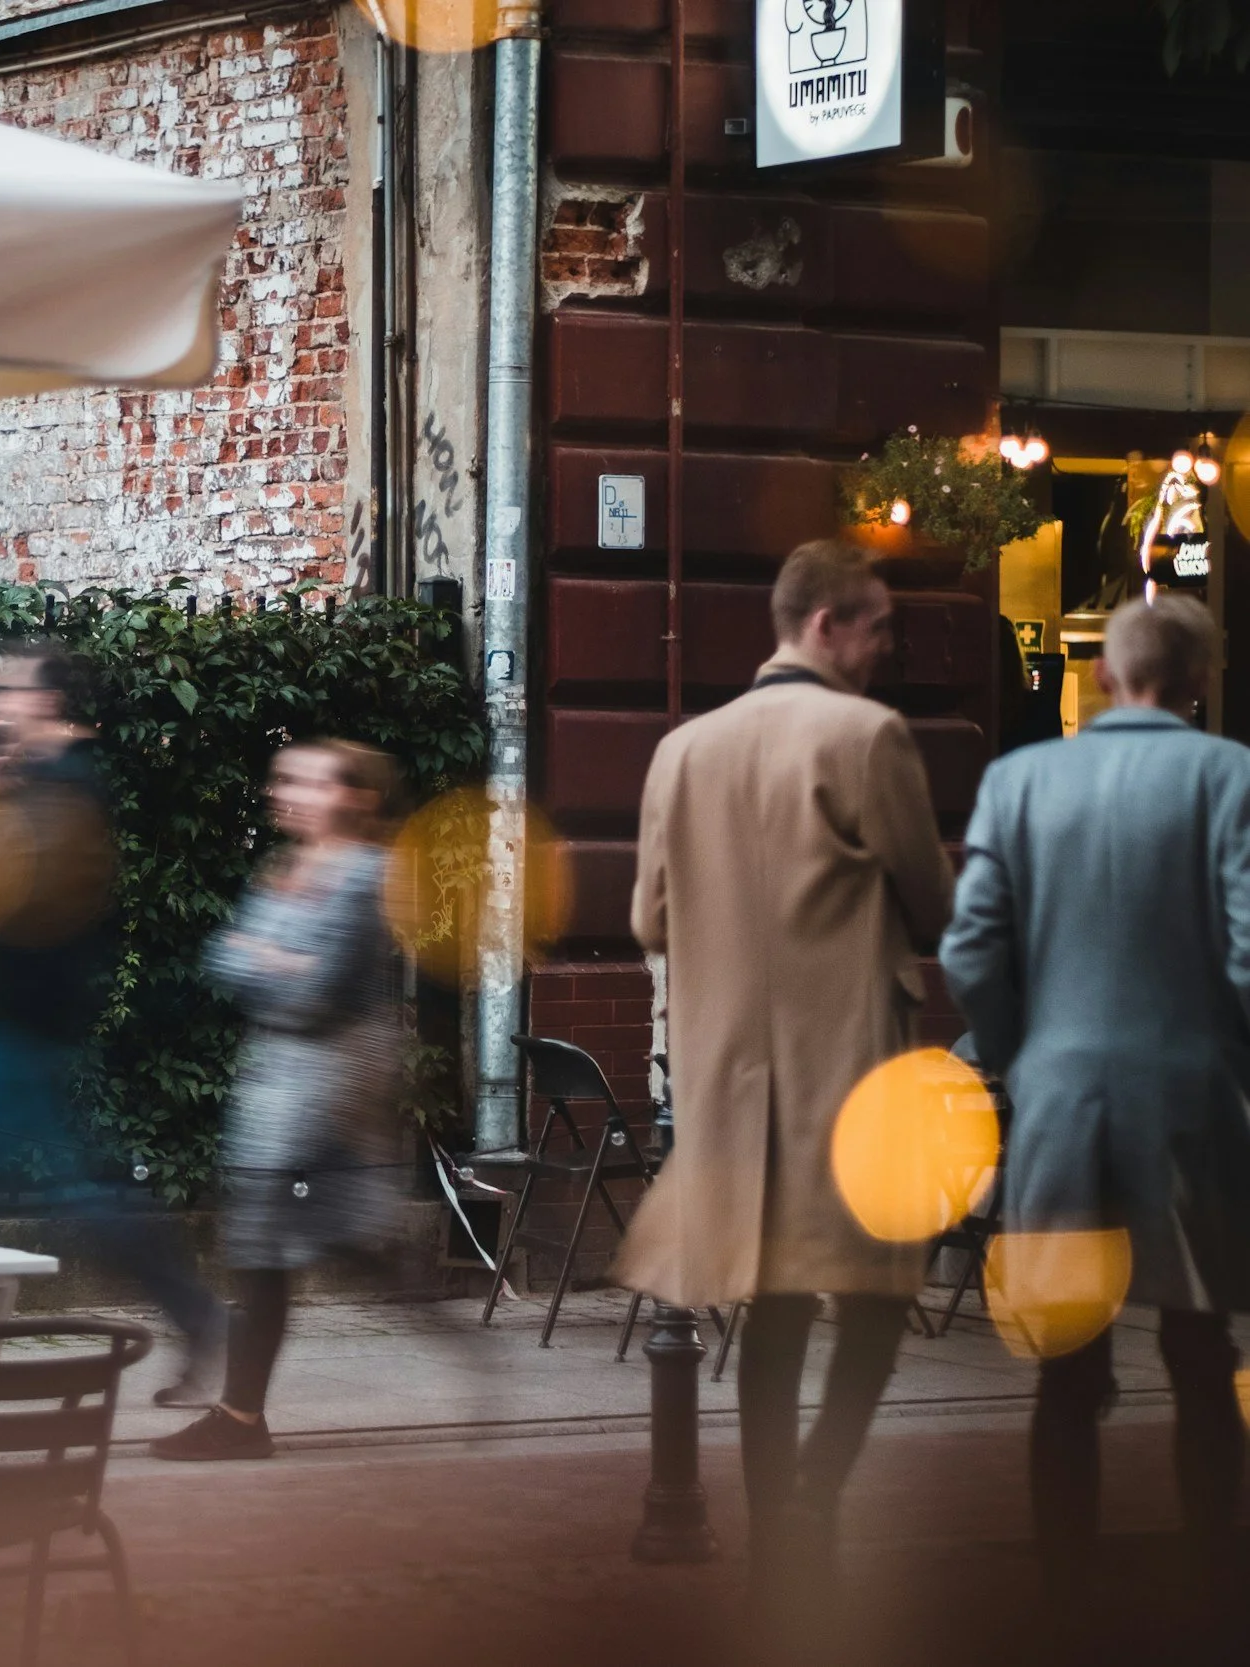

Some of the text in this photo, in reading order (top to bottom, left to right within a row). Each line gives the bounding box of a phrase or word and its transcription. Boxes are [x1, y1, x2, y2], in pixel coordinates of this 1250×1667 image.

[790, 69, 867, 108] UMAMITU
[810, 111, 819, 127] by
[605, 485, 617, 505] D
